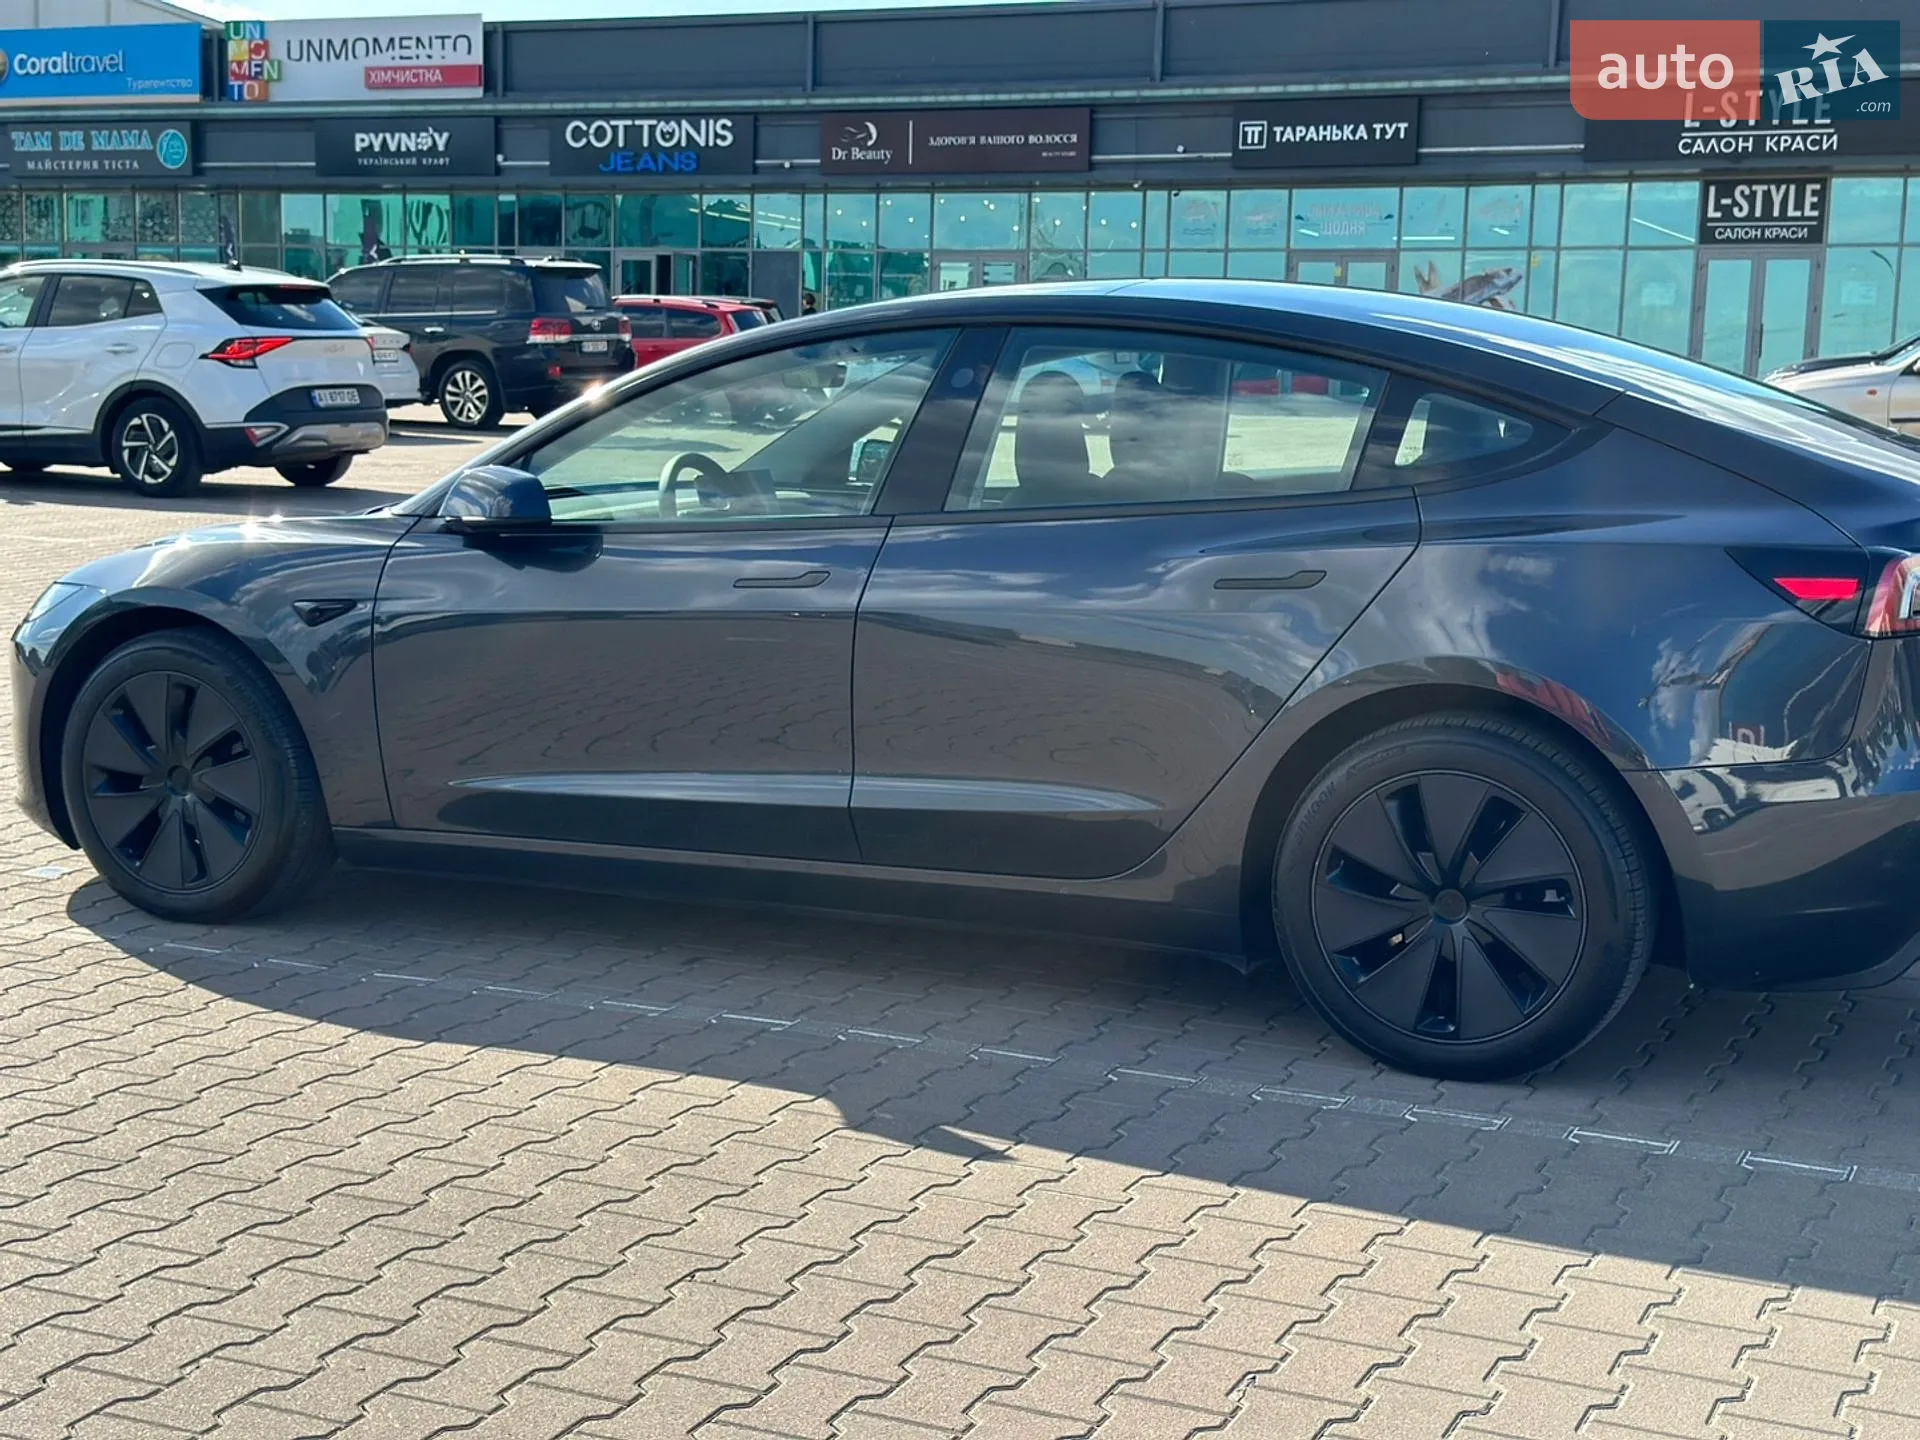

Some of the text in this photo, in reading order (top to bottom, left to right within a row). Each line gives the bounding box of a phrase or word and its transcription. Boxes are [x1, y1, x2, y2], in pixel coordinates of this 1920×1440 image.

[286, 34, 472, 62] UNMOMENTO
[368, 69, 443, 84] ХІМЧИСТКА
[565, 119, 734, 148] COTTONIS
[979, 133, 1025, 146] ВАШОГО
[1028, 133, 1078, 145] ВОЛОССЯ
[1273, 122, 1409, 142] ТАРАНЬКА ТУТ
[1678, 133, 1838, 155] САЛОН КРАСИ
[26, 159, 140, 171] МАЙСТЕРНЯ ТІСТА
[600, 152, 698, 172] JEANS
[831, 147, 893, 164] Dr Beauty
[1707, 184, 1820, 218] L-STYLE
[1714, 227, 1808, 240] САЛОН КРАСИ
